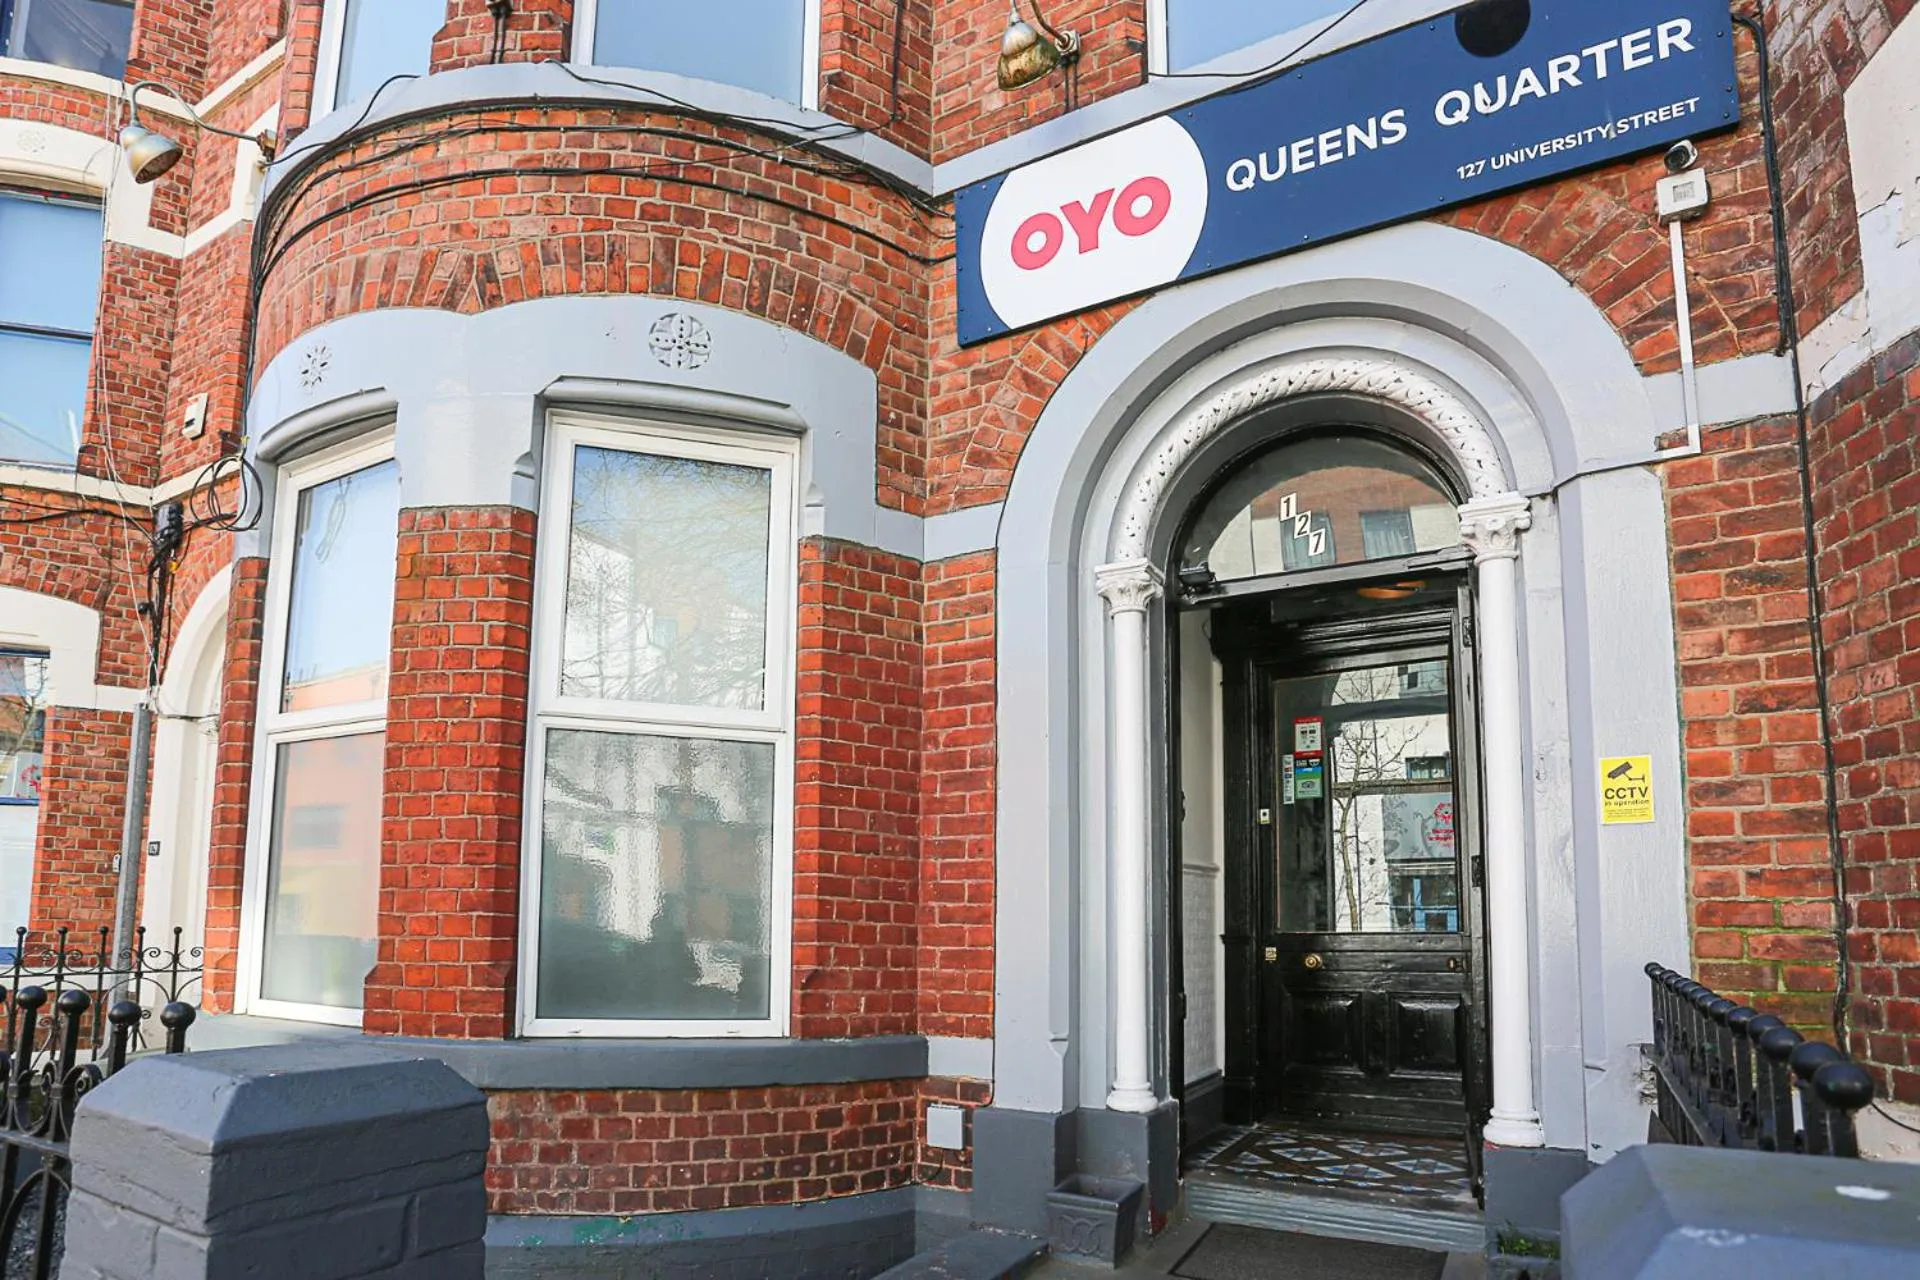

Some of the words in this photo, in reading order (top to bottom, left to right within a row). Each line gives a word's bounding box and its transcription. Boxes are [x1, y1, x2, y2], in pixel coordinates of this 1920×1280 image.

[1225, 109, 1408, 192] QUEENS
[1434, 18, 1696, 126] QUARTER
[1456, 160, 1486, 180] 127
[1490, 122, 1613, 171] UNIVERSITY
[1616, 96, 1700, 135] STREET
[1011, 176, 1172, 270] OYO
[1604, 786, 1649, 800] CCTV
